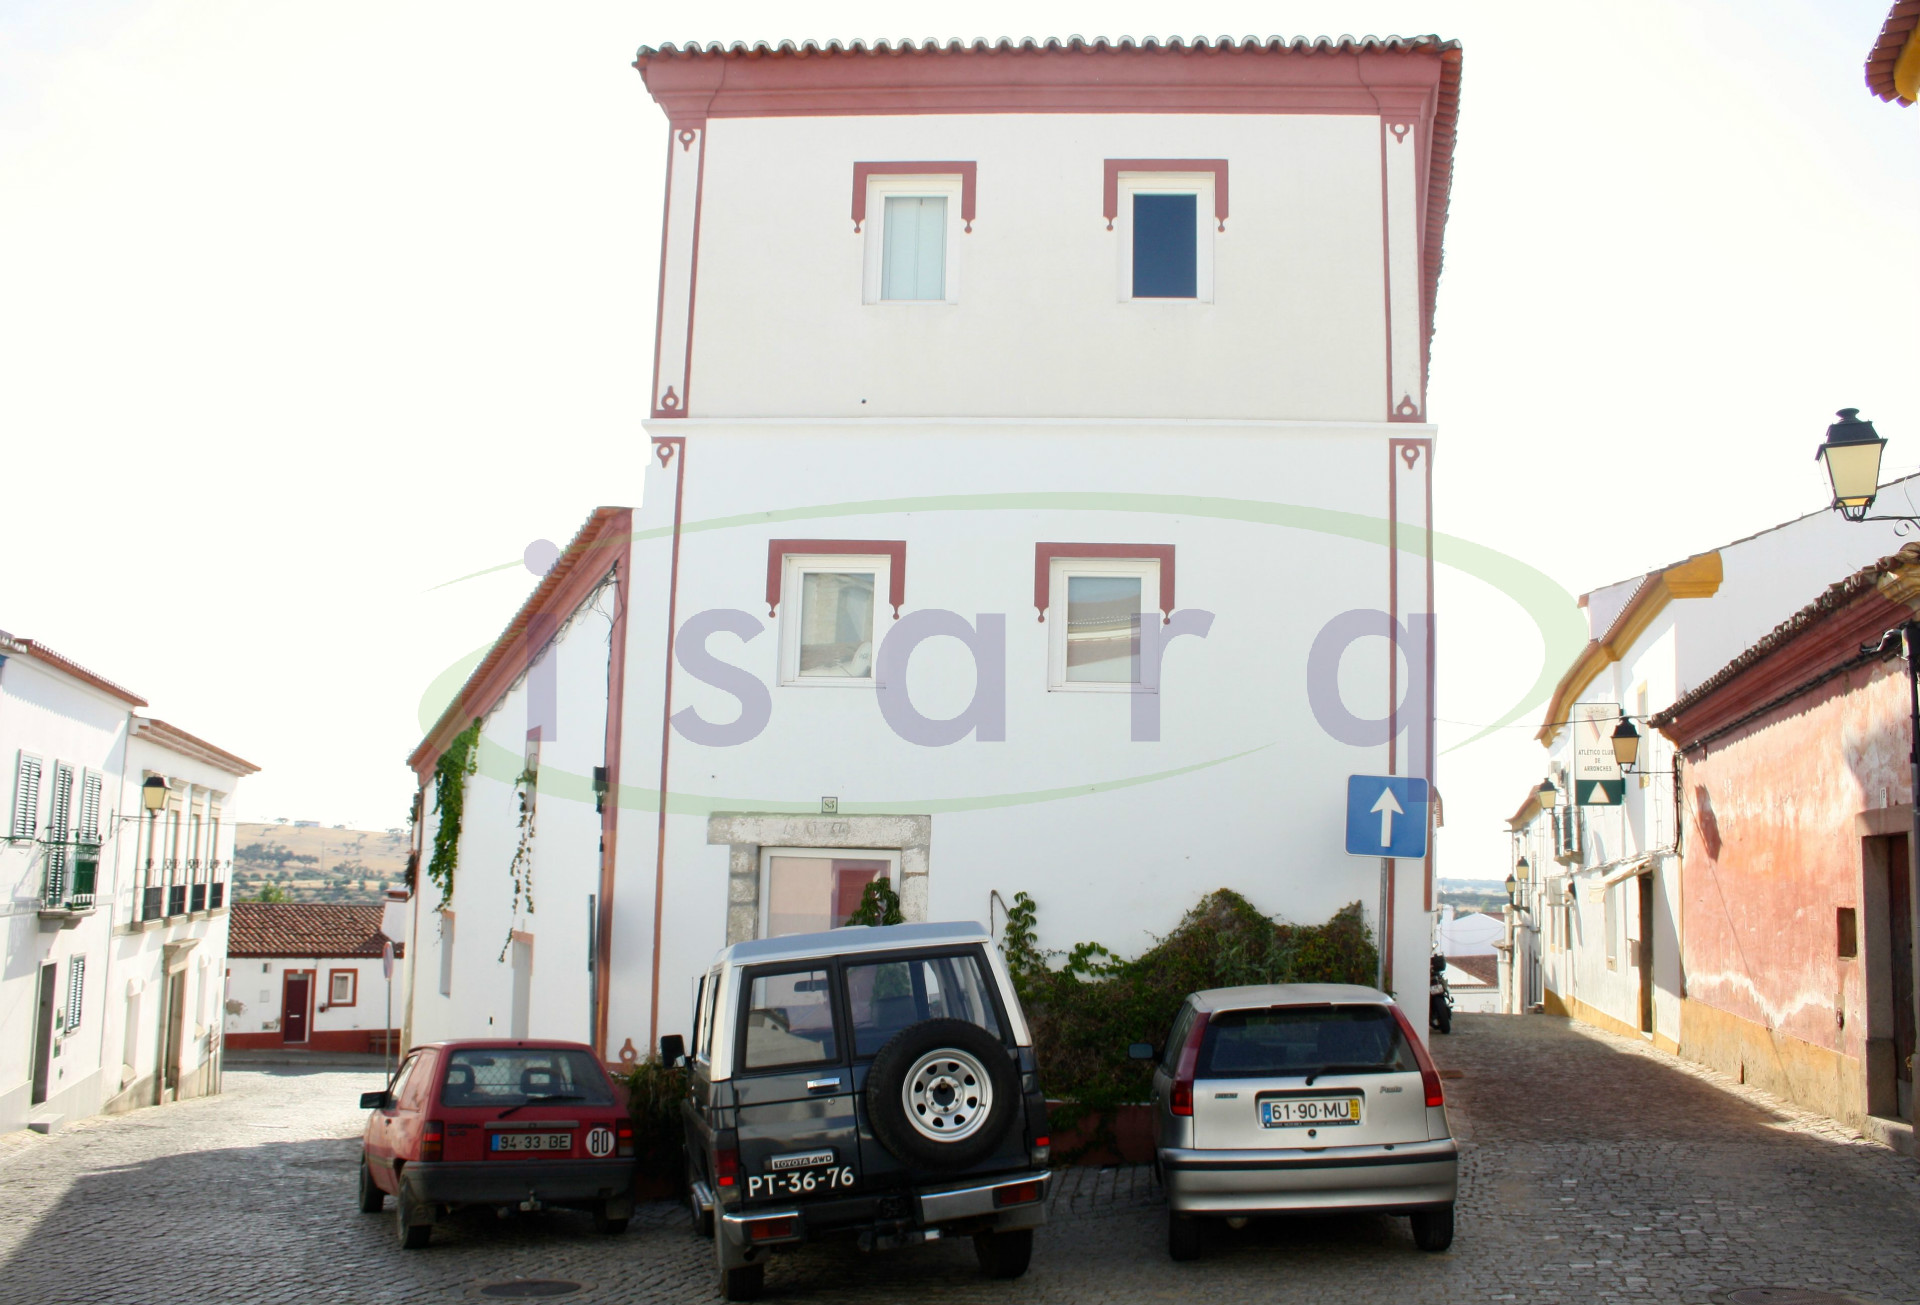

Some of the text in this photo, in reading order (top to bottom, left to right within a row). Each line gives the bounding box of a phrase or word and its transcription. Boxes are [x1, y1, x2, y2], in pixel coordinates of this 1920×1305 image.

[591, 1130, 609, 1153] 80
[775, 1159, 809, 1168] TOYOTA
[748, 1165, 855, 1198] PT-36-76
